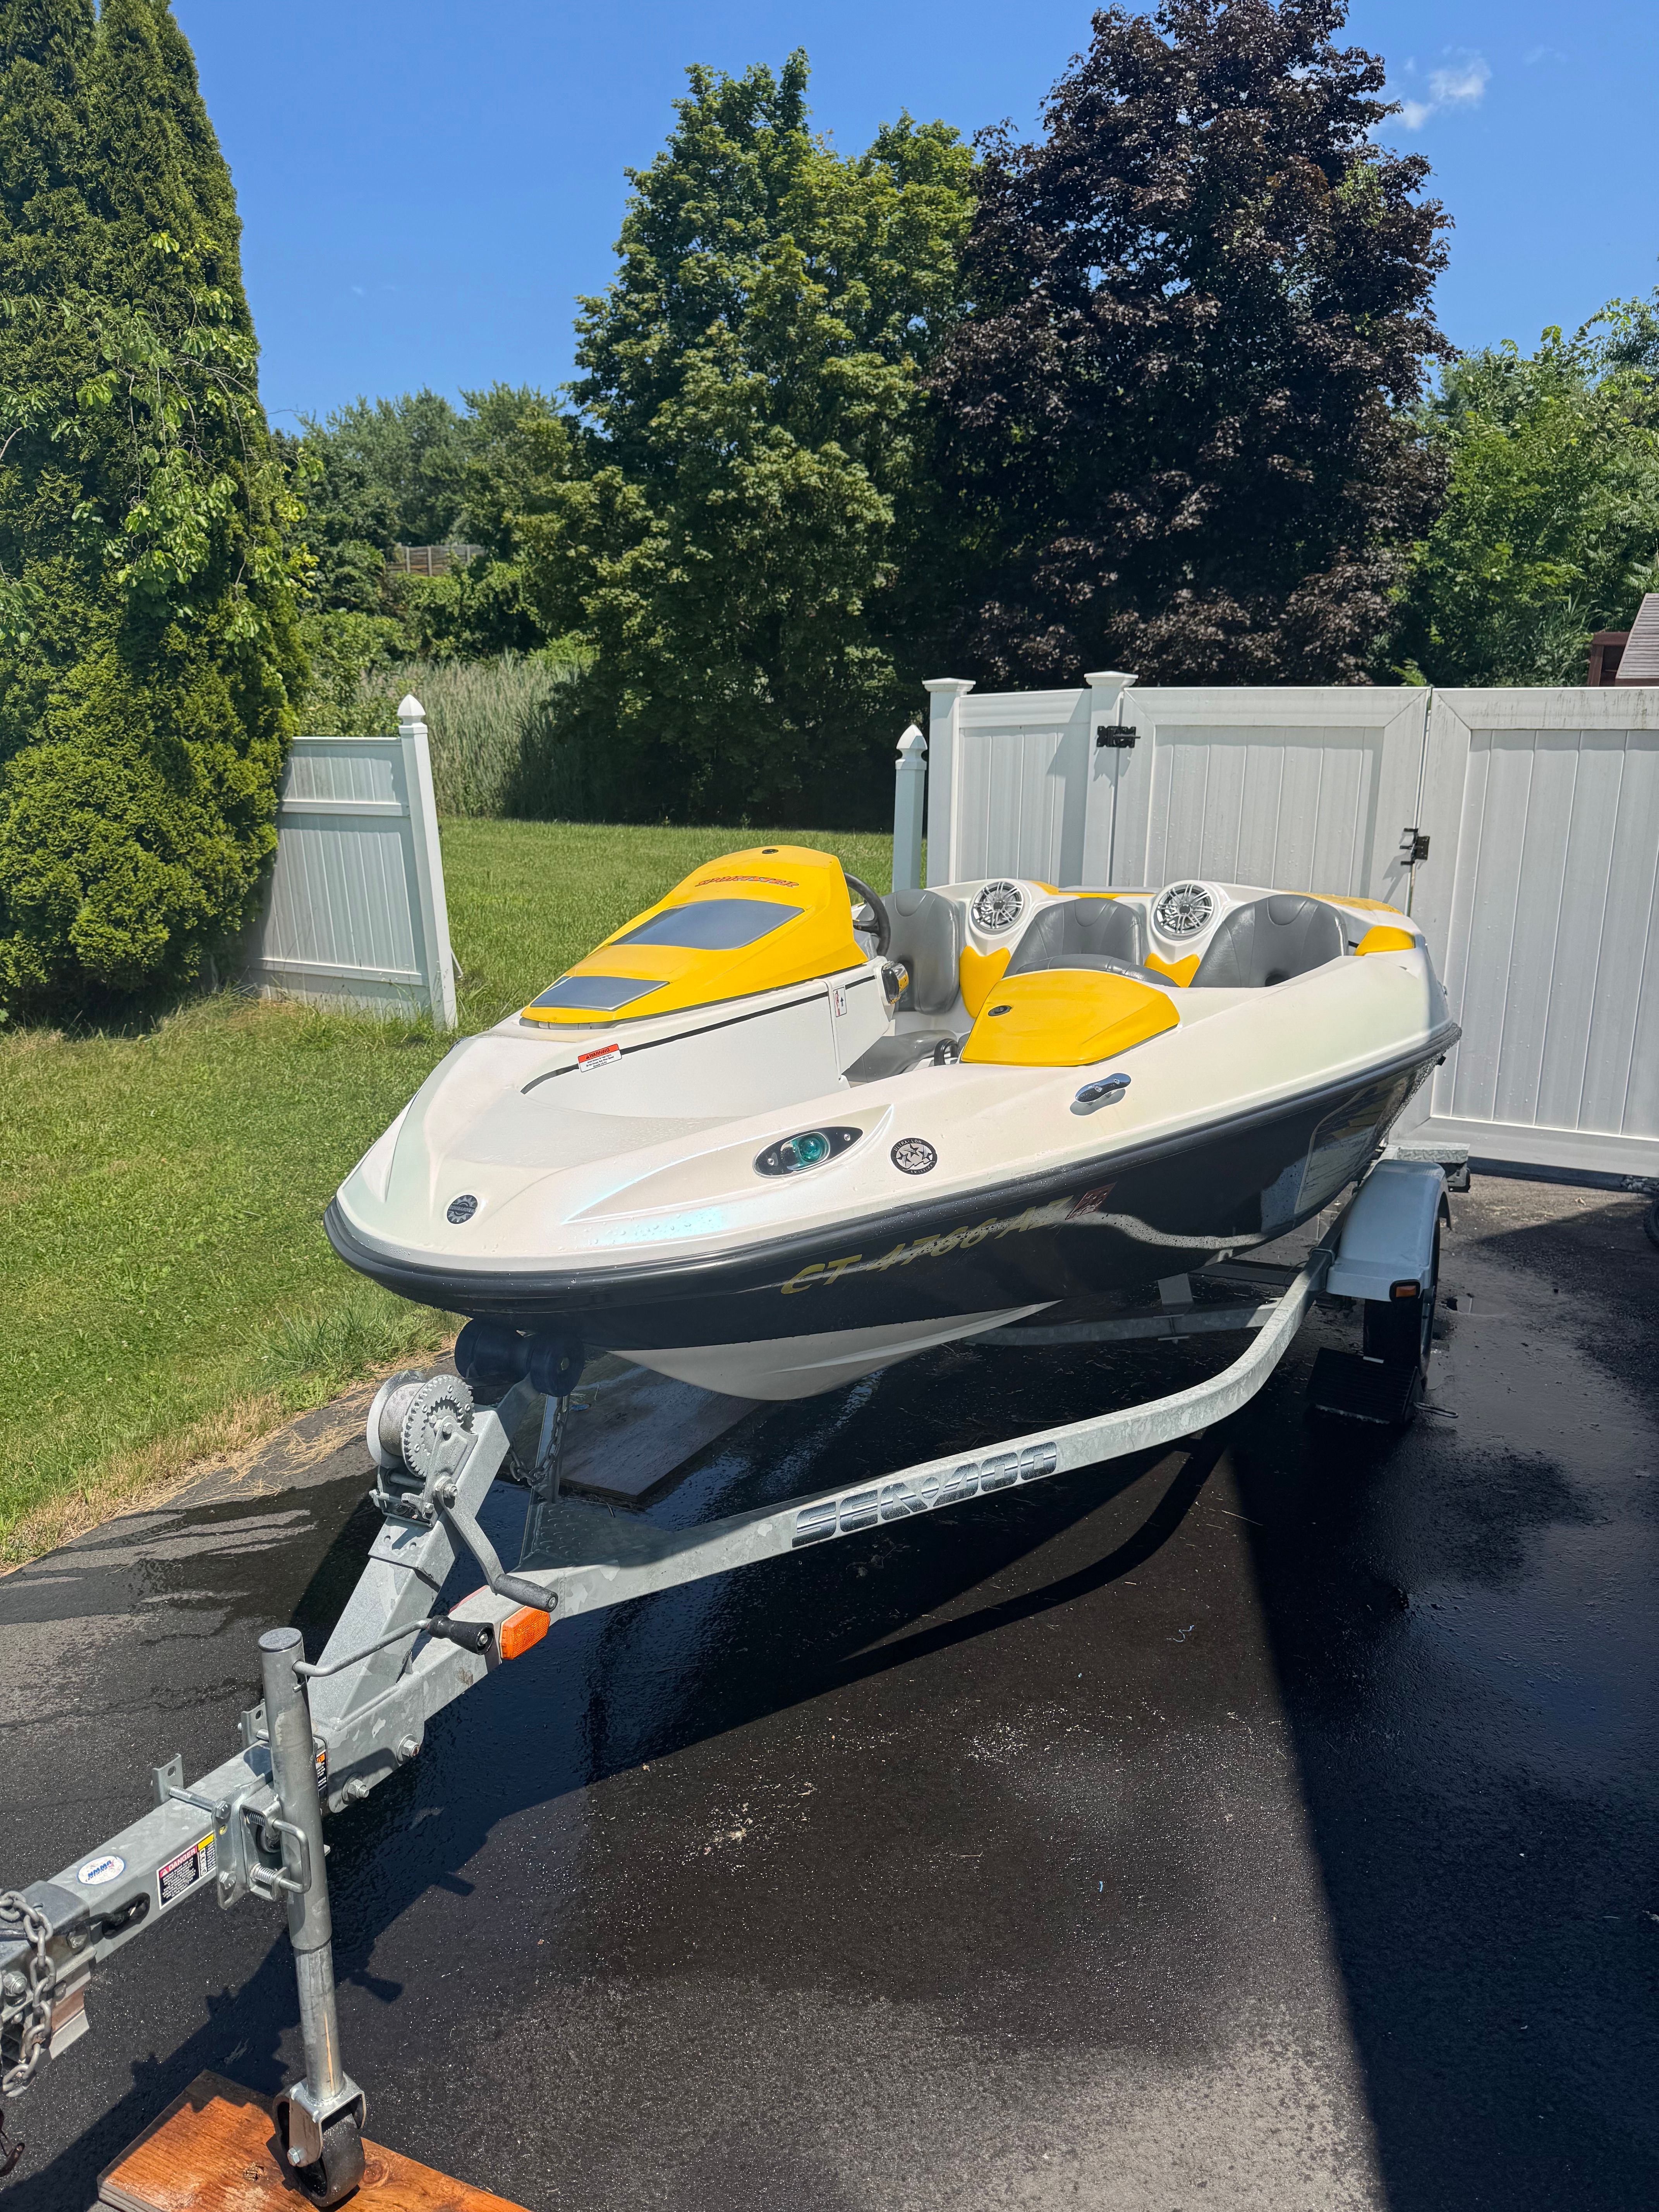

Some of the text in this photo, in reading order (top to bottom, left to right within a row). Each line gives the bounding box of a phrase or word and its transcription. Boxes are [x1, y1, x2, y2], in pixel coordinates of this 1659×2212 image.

[589, 1048, 610, 1057] WARNING
[781, 1254, 862, 1294] CT
[168, 1847, 196, 1872] DANGER
